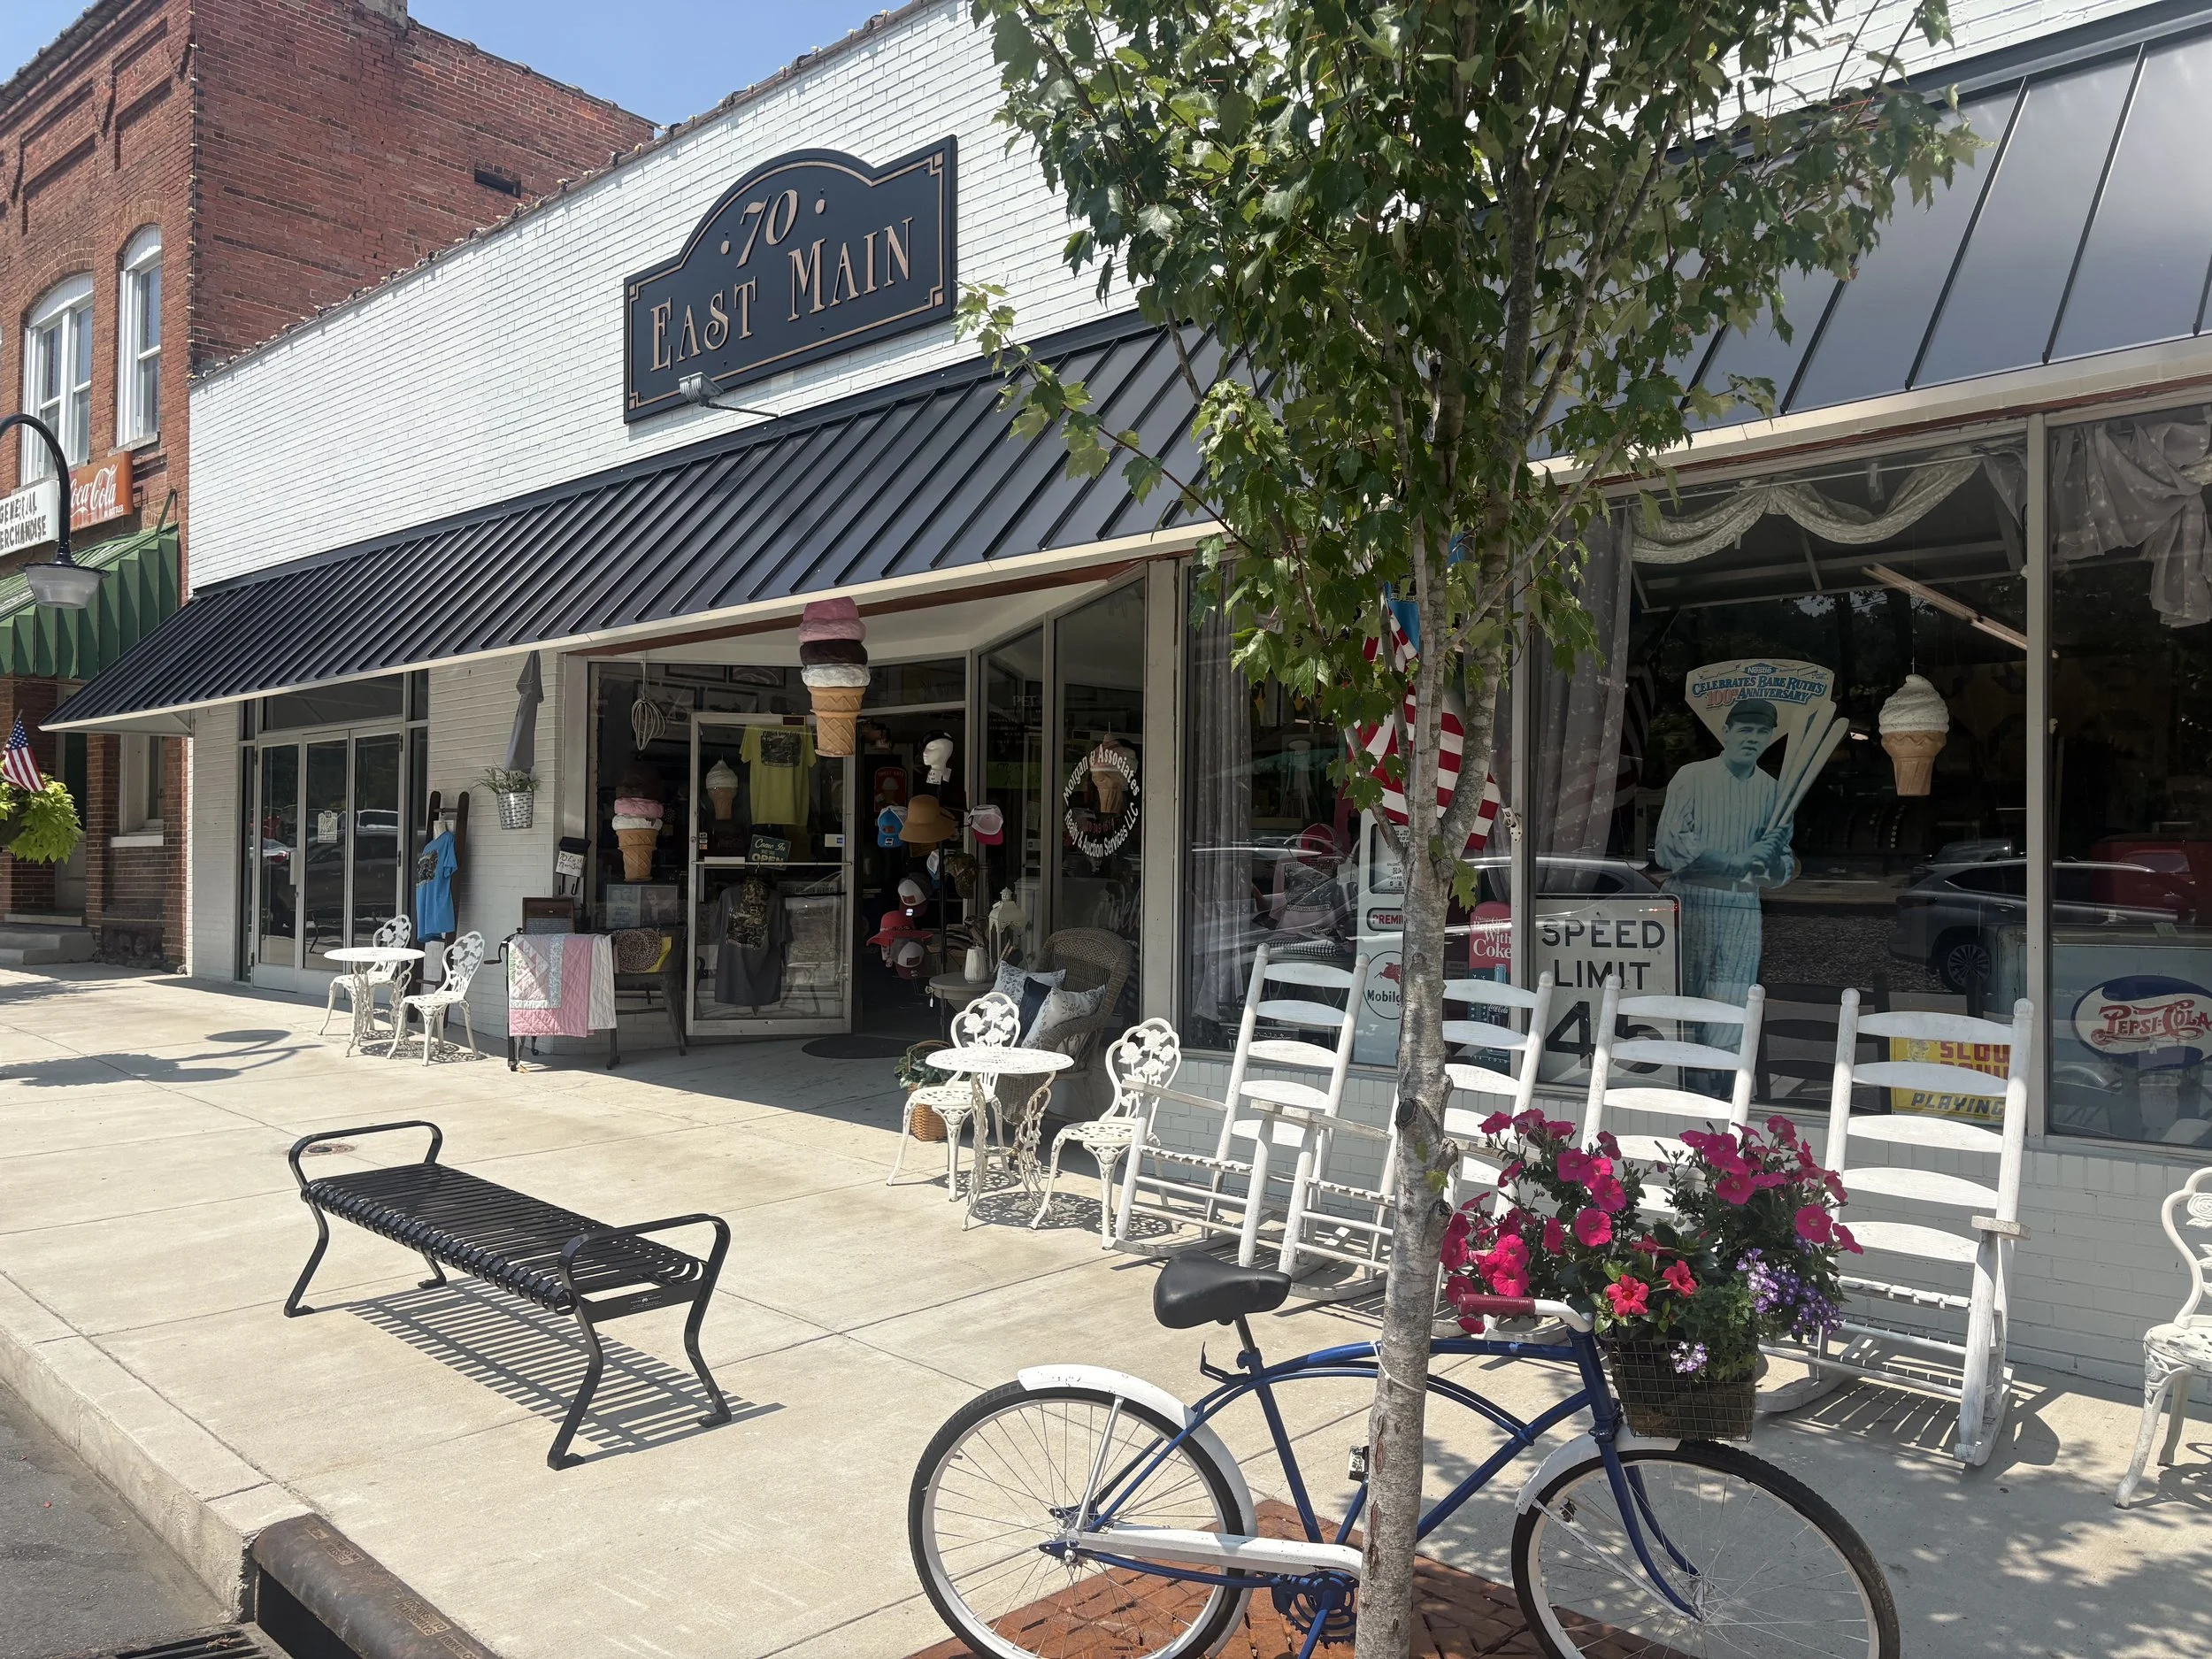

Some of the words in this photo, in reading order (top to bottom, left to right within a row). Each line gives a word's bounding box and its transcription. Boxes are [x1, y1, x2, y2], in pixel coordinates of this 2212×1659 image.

[736, 189, 798, 268] 70
[649, 276, 757, 373] EAST
[787, 217, 913, 322] MAIN
[0, 514, 47, 549] ERCHANDISE
[1692, 676, 1756, 696] CELEBRATES
[1757, 675, 1786, 688] BABE
[1788, 677, 1826, 694] RUTH'S
[1737, 687, 1810, 703] ANNIVERSARY
[1063, 756, 1088, 807] Morgan
[1097, 743, 1140, 796] Associates
[1064, 809, 1079, 845] Realty
[1078, 831, 1084, 849] &
[1081, 835, 1103, 858] Auction
[1103, 824, 1128, 856] Services
[1125, 802, 1139, 831] LLC
[755, 838, 774, 849] Come
[775, 842, 786, 851] In
[752, 853, 784, 867] OPEN
[1372, 913, 1404, 925] PREMI
[1485, 929, 1511, 944] With
[1541, 918, 1666, 949] SPEED
[1473, 938, 1512, 959] Coke
[1554, 959, 1651, 990] LIMIT
[1367, 989, 1402, 1006] Mobilg
[1911, 1093, 2006, 1116] PLAYING
[434, 1622, 447, 1631] TO
